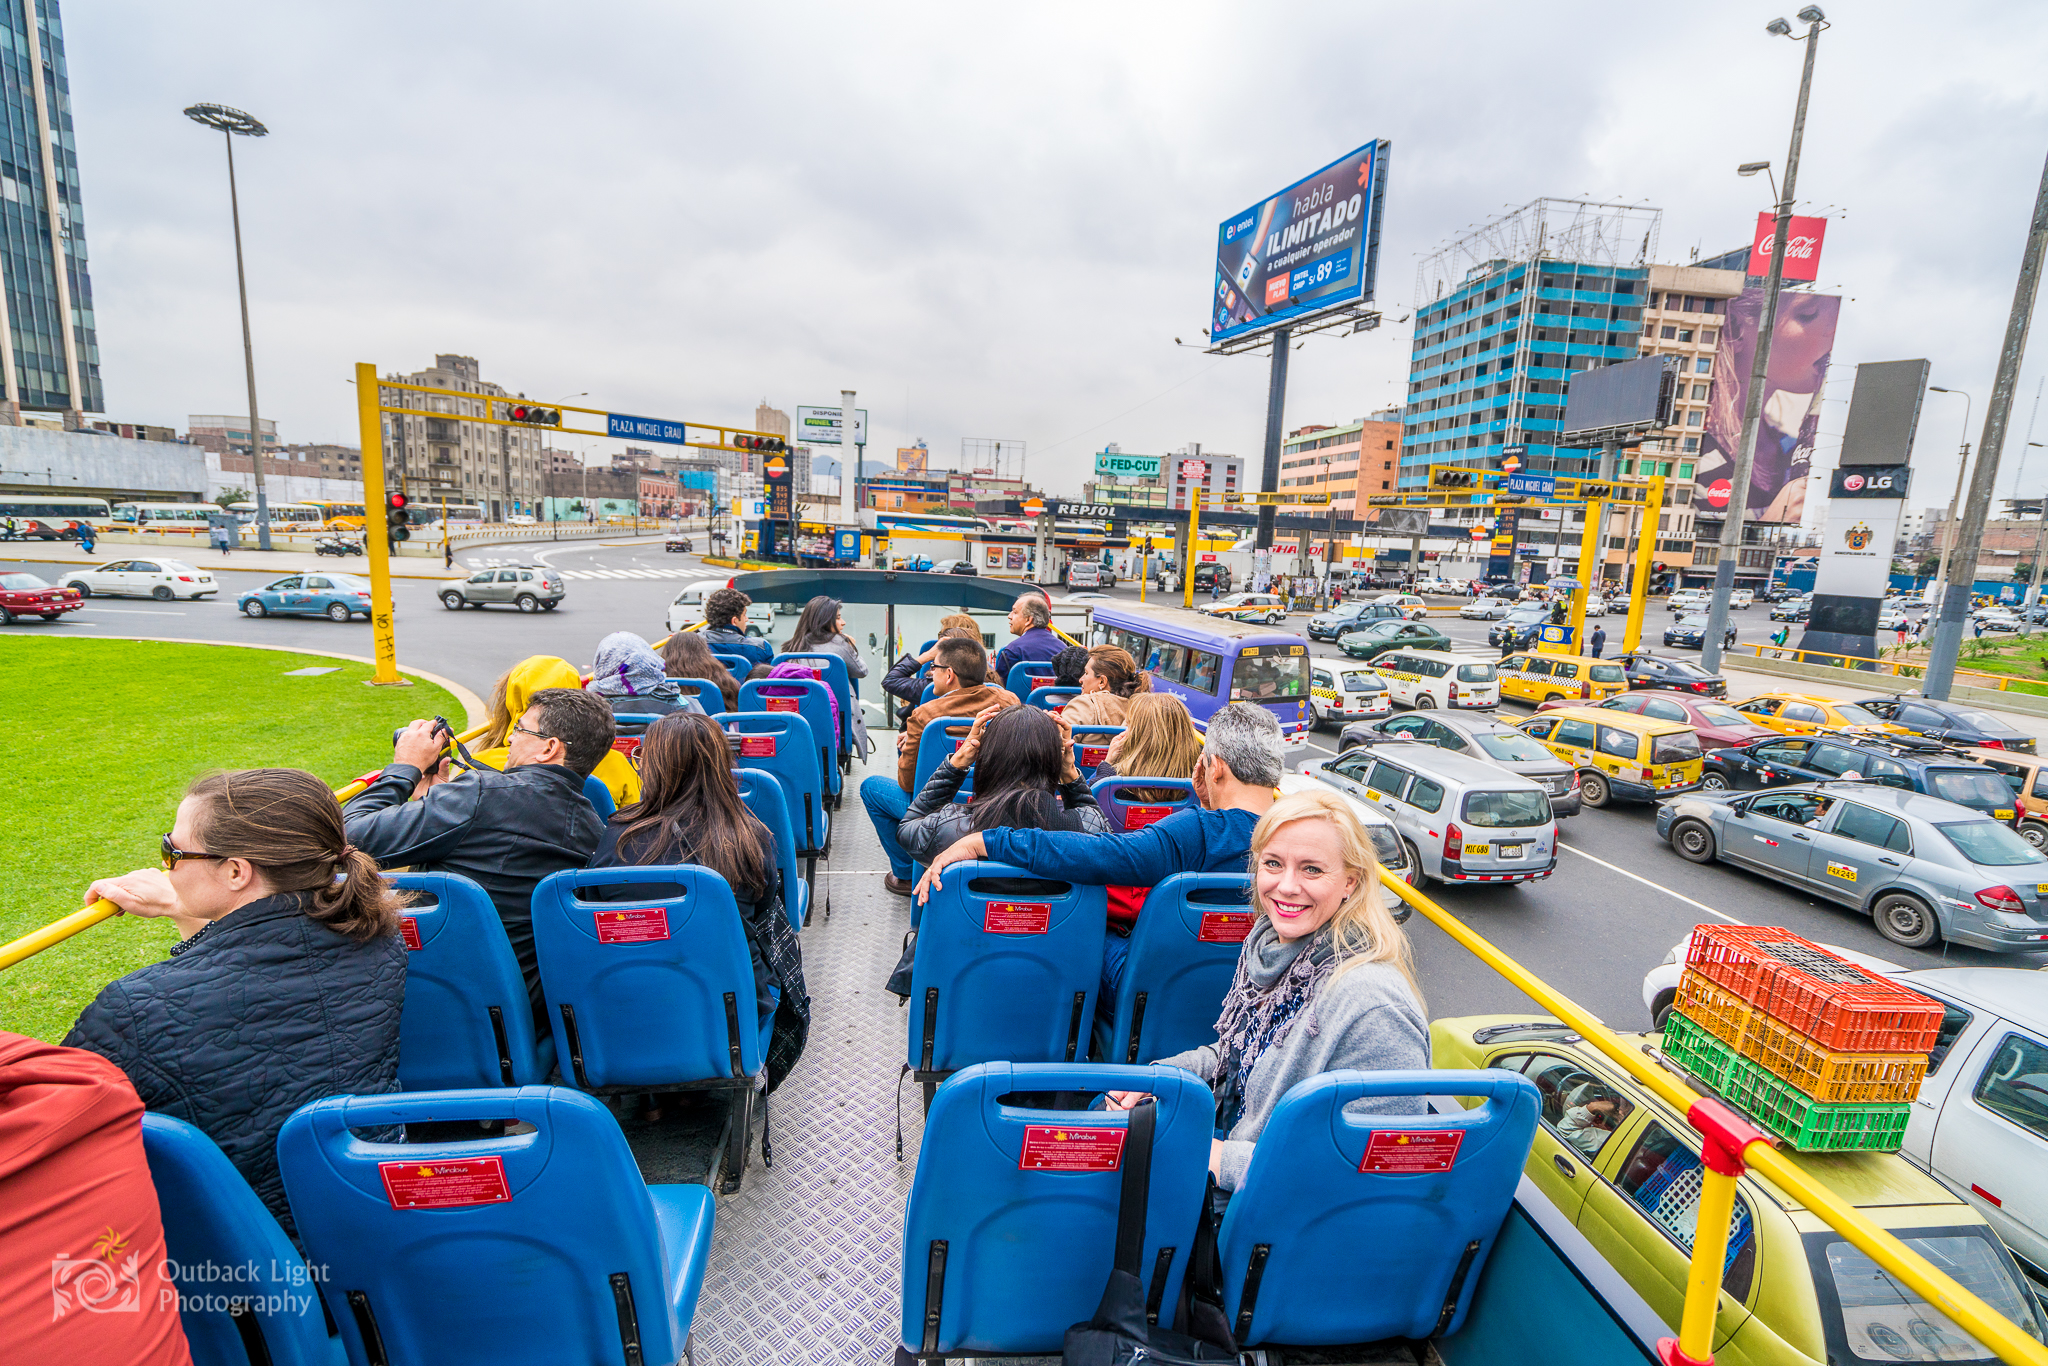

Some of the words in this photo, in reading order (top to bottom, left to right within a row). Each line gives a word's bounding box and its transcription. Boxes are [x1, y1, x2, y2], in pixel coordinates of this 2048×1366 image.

[1292, 182, 1334, 218] habla
[1237, 215, 1254, 233] entel
[1266, 193, 1362, 258] ILIMITADO
[1267, 262, 1272, 272] a
[1273, 245, 1311, 270] cualquier
[1313, 226, 1356, 252] operador
[1293, 270, 1309, 281] ENTEL
[1293, 280, 1305, 290] CHIP
[1316, 261, 1332, 282] 89
[1269, 278, 1286, 291] NUEVO
[1273, 288, 1286, 298] PLAN
[611, 419, 634, 433] PLAZA
[637, 422, 661, 436] MIGUEL
[664, 426, 682, 439] GRAU
[1110, 459, 1158, 471] FED-CUT
[1510, 479, 1524, 490] PLAZA
[1525, 480, 1540, 492] MIGUEL
[1542, 482, 1553, 493] GRAU
[1867, 476, 1892, 489] LG
[1058, 504, 1116, 516] REPSOL
[376, 614, 390, 629] NO
[1465, 845, 1475, 854] MIC
[434, 1166, 468, 1175] Mirabus
